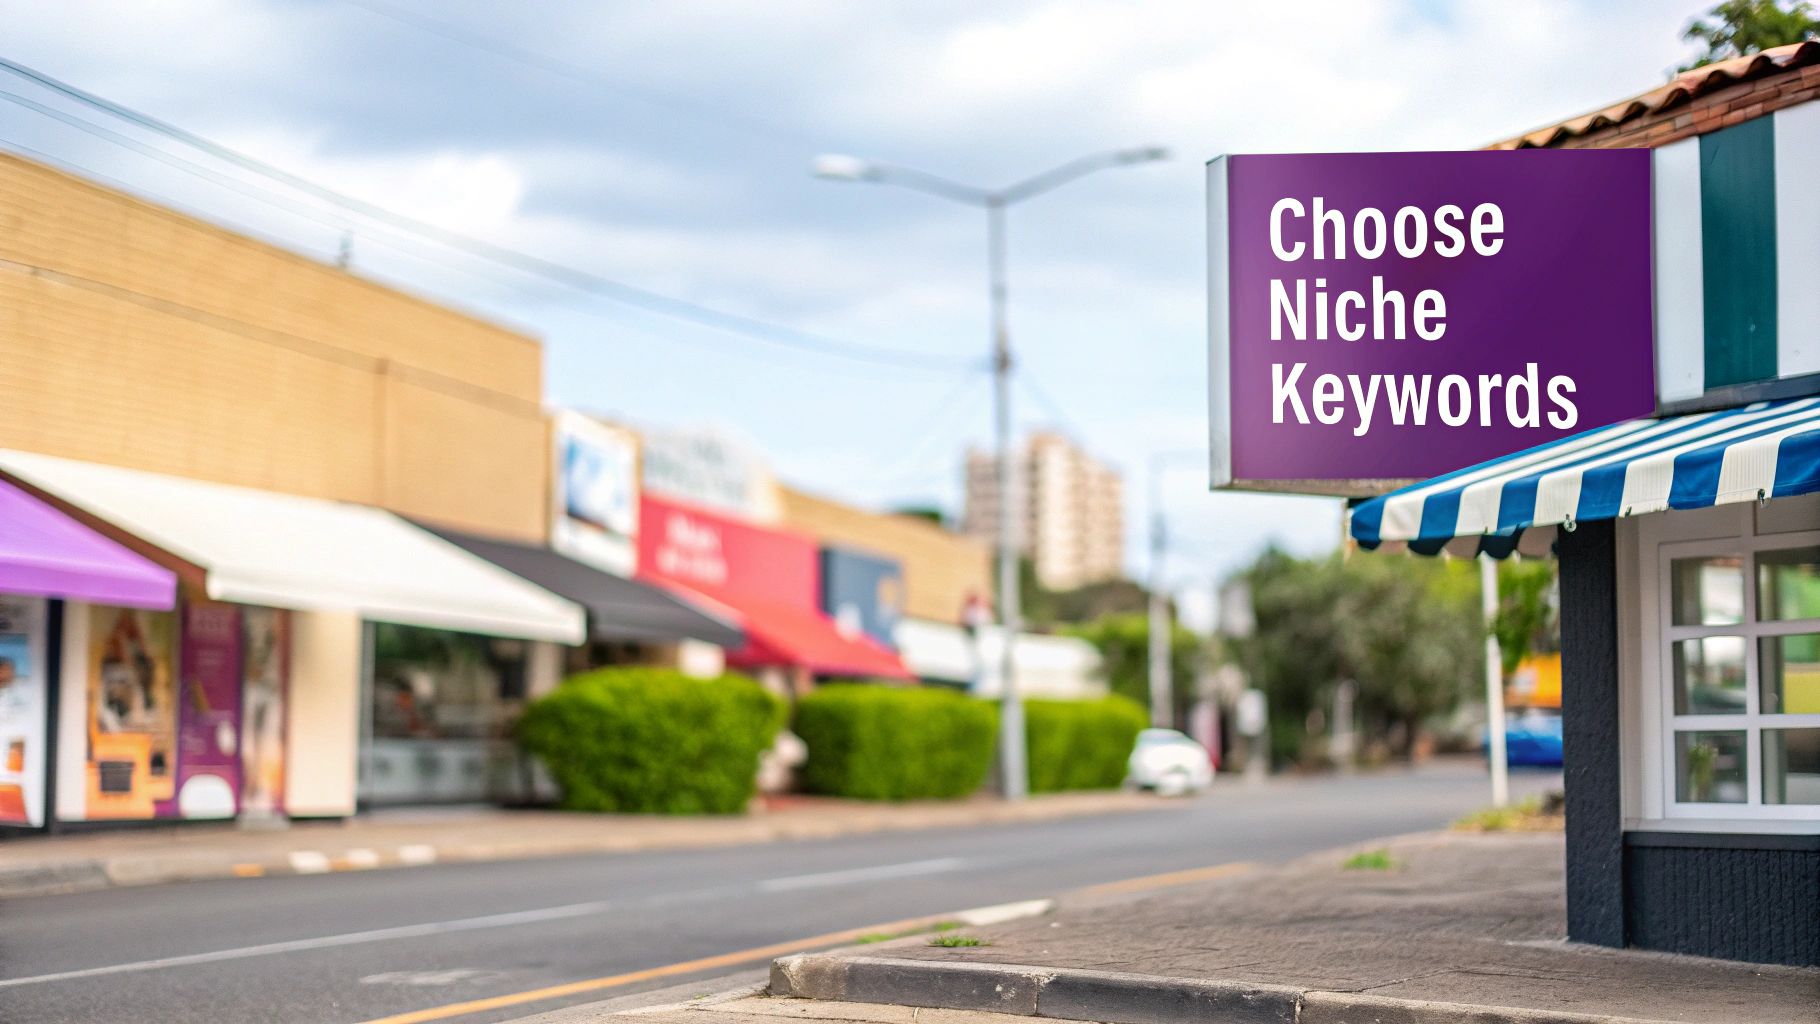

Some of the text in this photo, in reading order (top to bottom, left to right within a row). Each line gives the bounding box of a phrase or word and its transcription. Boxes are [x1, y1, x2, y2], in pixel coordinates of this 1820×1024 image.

[1269, 196, 1504, 262] Choose
[1270, 275, 1447, 342] Niche
[1271, 362, 1578, 437] Keywords
